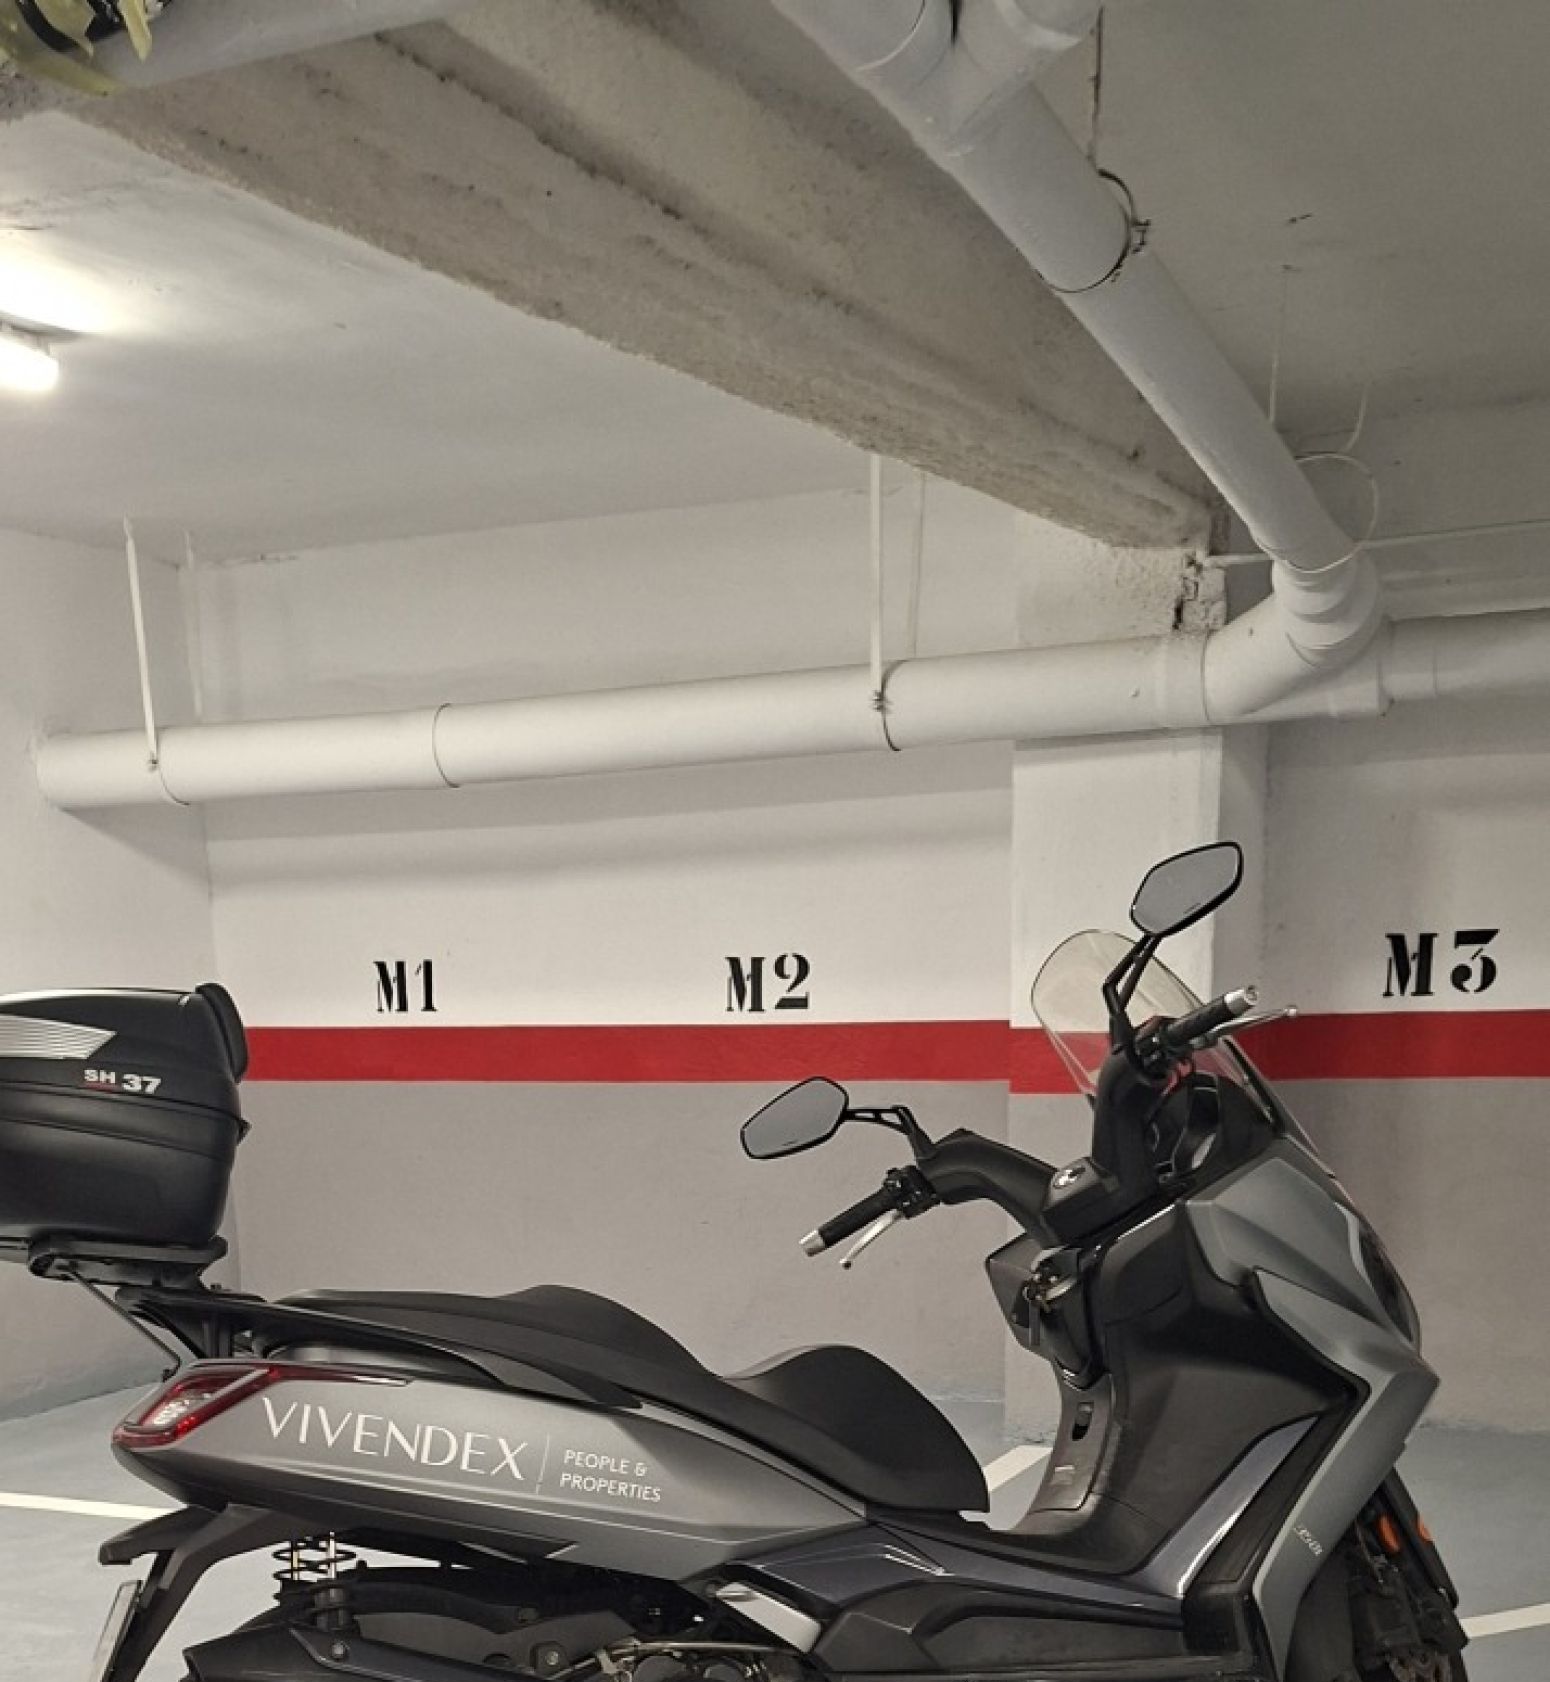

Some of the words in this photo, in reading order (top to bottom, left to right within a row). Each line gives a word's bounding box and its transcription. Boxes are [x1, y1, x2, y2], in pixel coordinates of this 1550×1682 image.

[373, 959, 437, 1012] M1
[725, 953, 810, 1012] M2
[1382, 928, 1499, 998] M3
[83, 1069, 116, 1084] SH
[122, 1073, 162, 1095] 37
[262, 1397, 528, 1481] VIVENDEX
[564, 1449, 630, 1475] PEOPLE
[634, 1462, 648, 1478] &
[559, 1473, 662, 1502] PROPERTIES
